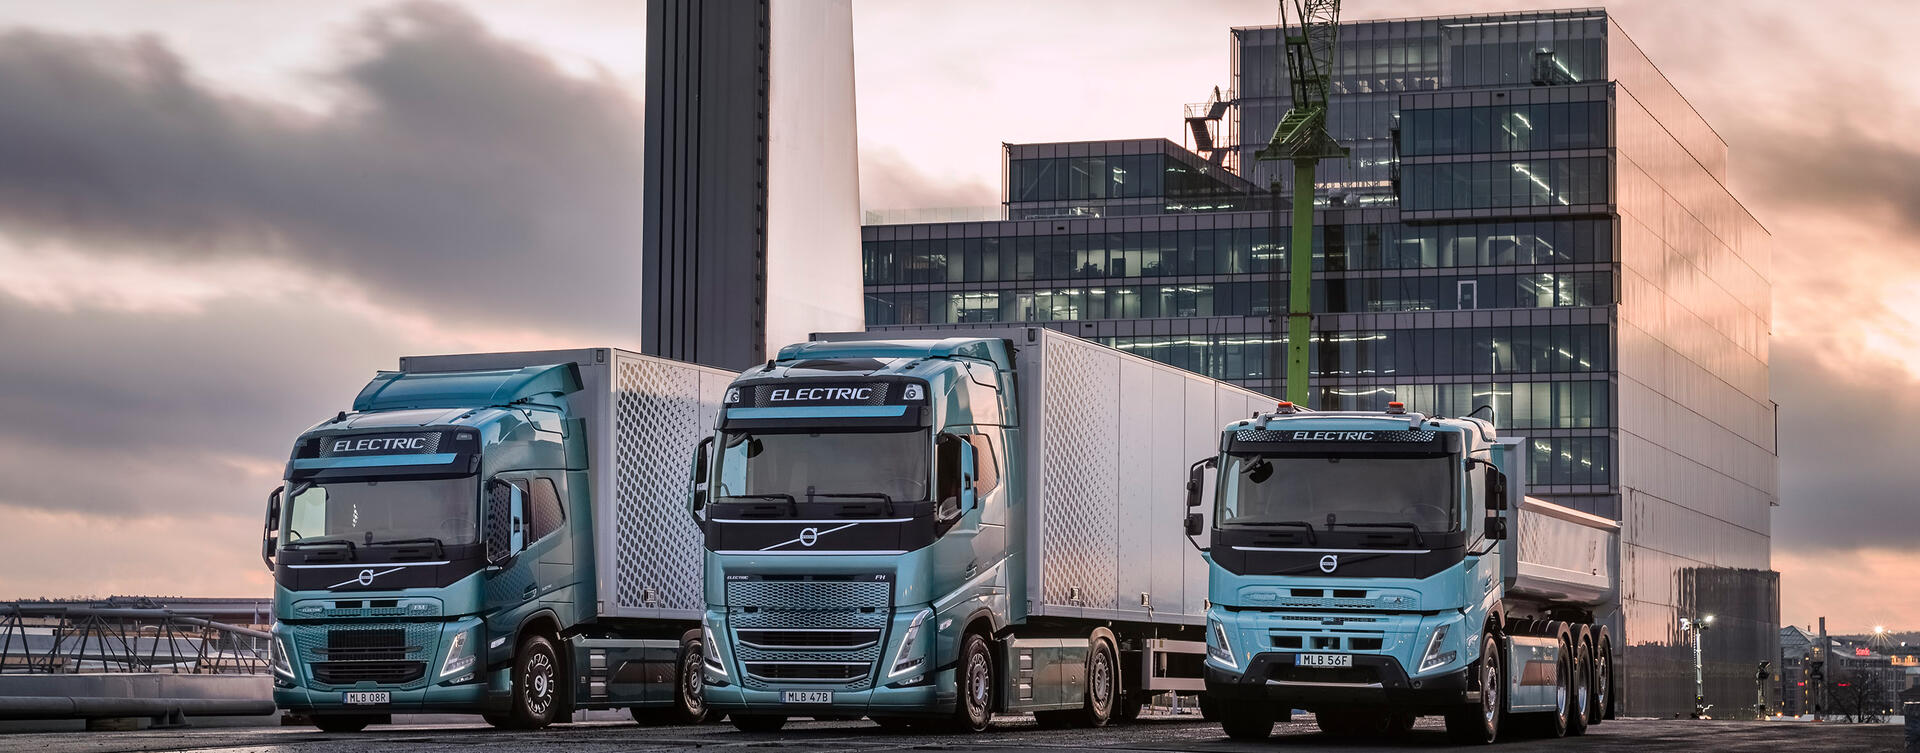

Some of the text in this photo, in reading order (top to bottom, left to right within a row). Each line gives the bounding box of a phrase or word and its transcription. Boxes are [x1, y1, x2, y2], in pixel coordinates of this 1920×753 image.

[770, 388, 872, 401] ELECTRIC
[1293, 431, 1374, 440] ELECTRIC
[333, 438, 426, 452] ELECTRIC
[1303, 655, 1348, 666] MLB 56F
[350, 692, 386, 703] MLB 08R
[788, 692, 828, 702] MLB 47B
